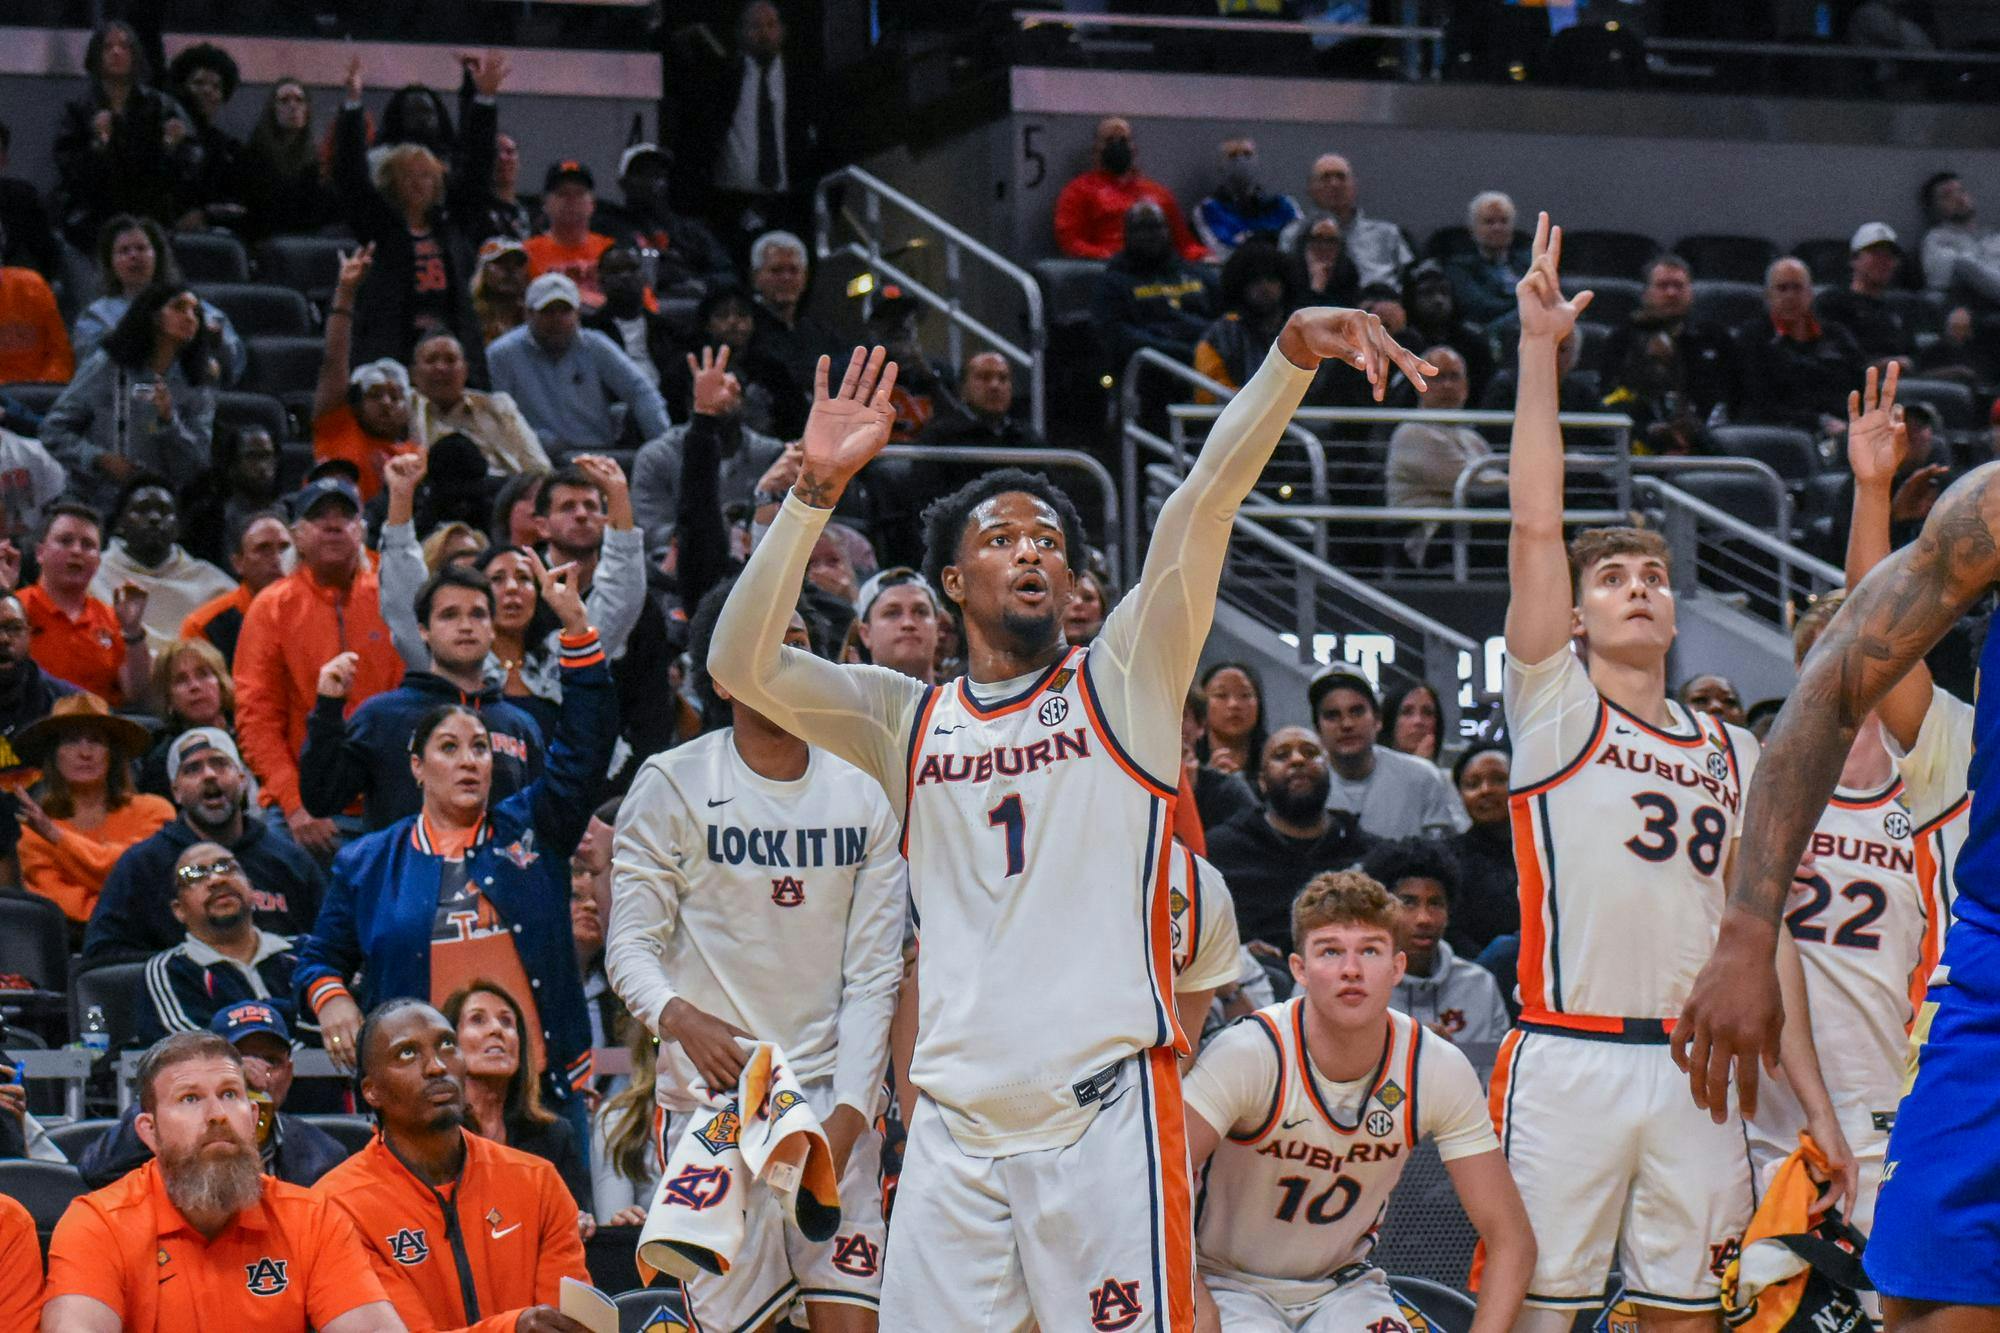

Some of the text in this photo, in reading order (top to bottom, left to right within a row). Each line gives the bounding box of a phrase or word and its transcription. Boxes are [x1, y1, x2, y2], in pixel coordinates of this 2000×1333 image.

[1023, 125, 1048, 189] 5
[1038, 697, 1069, 727] SEC
[916, 727, 1091, 786] AUBURN
[1595, 743, 1740, 816] AUBURN
[707, 824, 791, 868] LOCK
[796, 828, 828, 868] IT
[988, 793, 1026, 878] 1
[1624, 790, 1726, 877] 38
[1784, 874, 1888, 951] 22
[1274, 1174, 1363, 1225] 10
